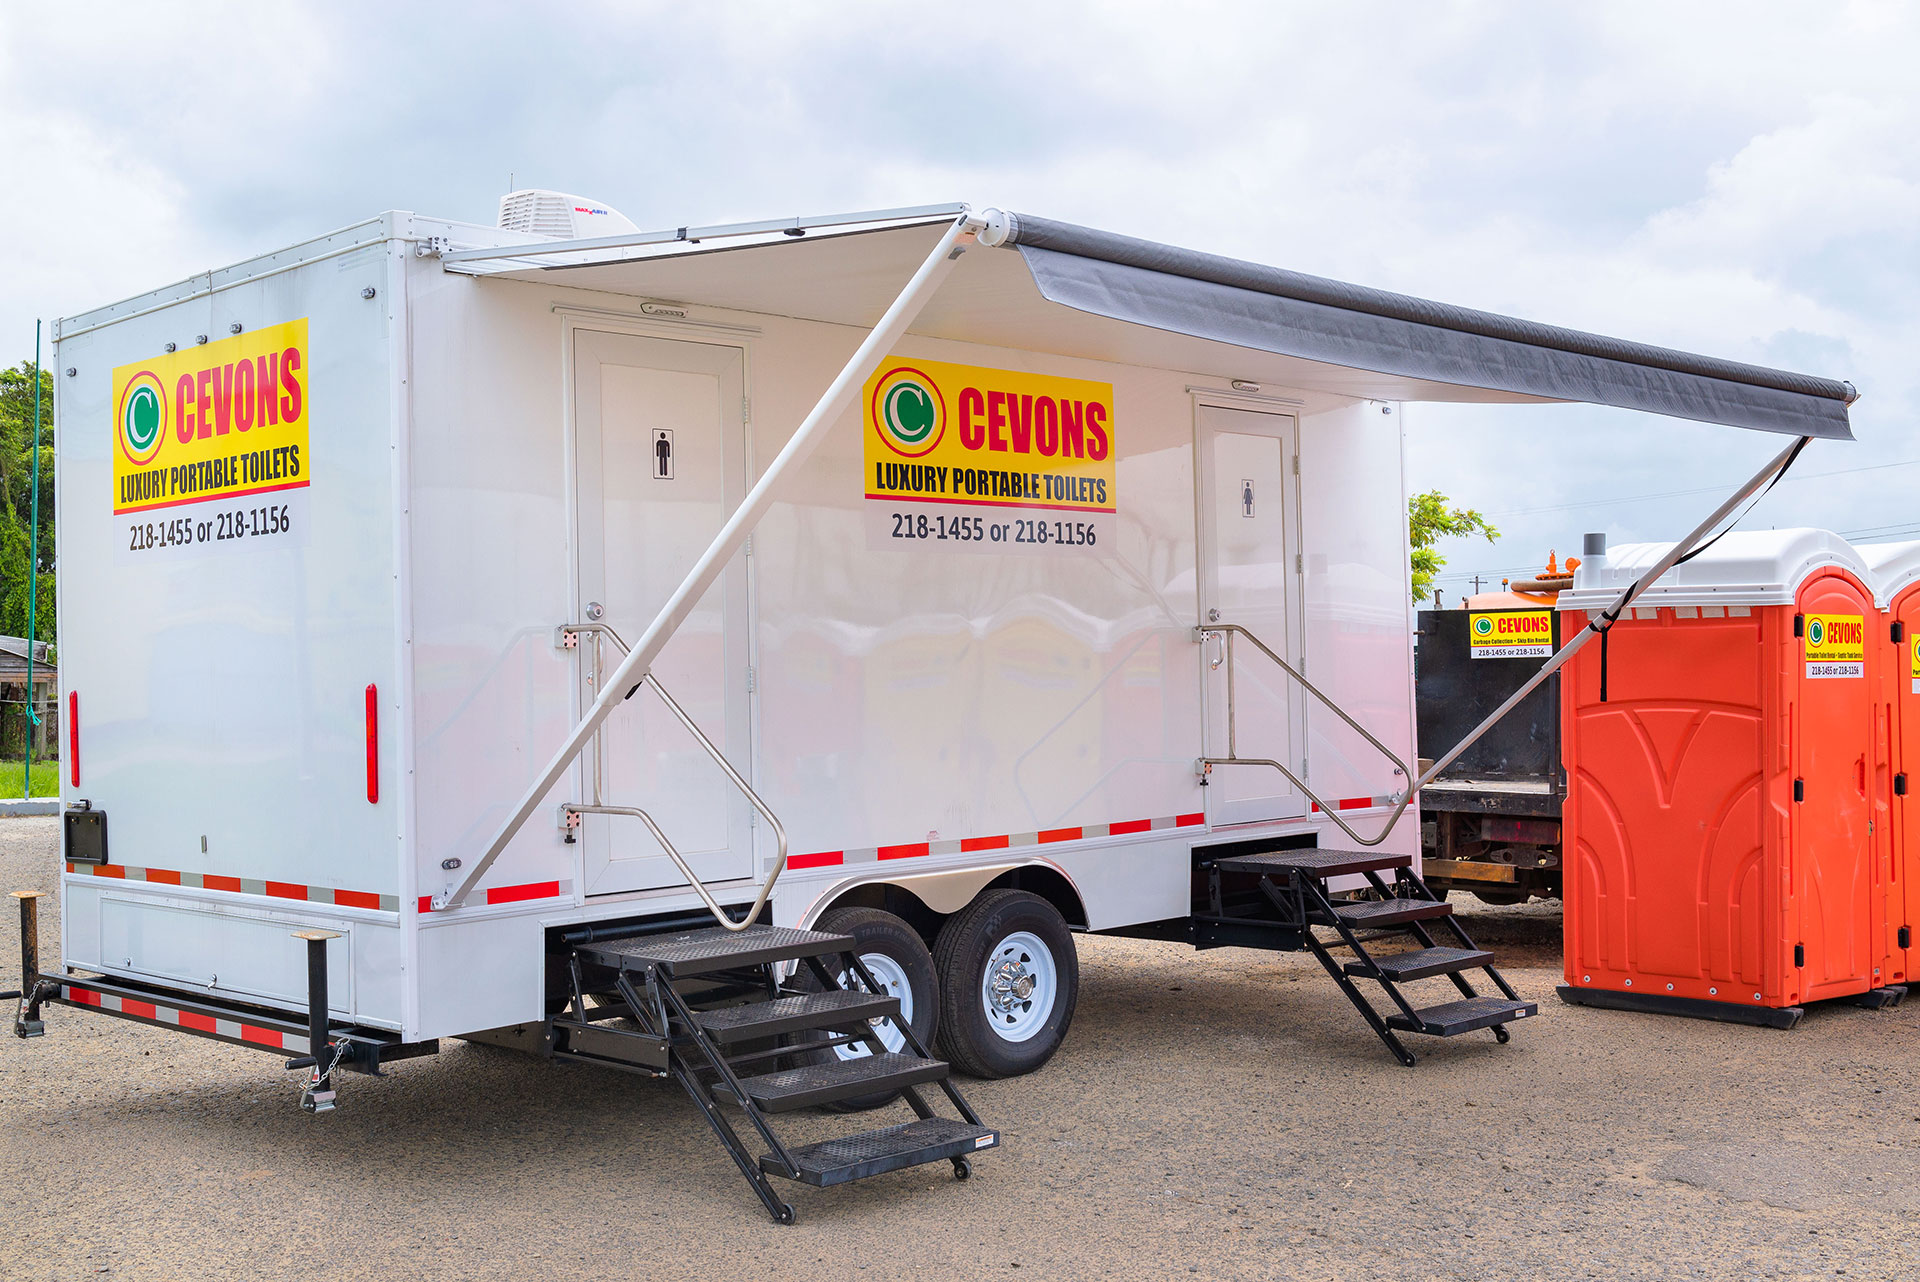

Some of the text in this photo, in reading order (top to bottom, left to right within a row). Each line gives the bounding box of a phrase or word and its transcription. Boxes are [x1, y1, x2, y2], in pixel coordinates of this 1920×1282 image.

[176, 347, 301, 444] CEVONS
[958, 387, 1108, 461] CEVONS
[120, 444, 300, 503] LUXURY PORTABLE TOILETS
[876, 462, 1106, 504] LUXURY PORTABLE TOILETS
[130, 504, 290, 551] 218-1455 or 218-1156
[892, 513, 1096, 546] 218-1455 or 218-1156
[1498, 616, 1548, 634] CEVONS
[1828, 622, 1862, 644] CEVONS
[1478, 648, 1507, 656] 218-1455
[1516, 648, 1545, 656] 218-1156
[1812, 666, 1860, 675] 218-1455 or 218-1156
[861, 926, 894, 937] TRAILER
